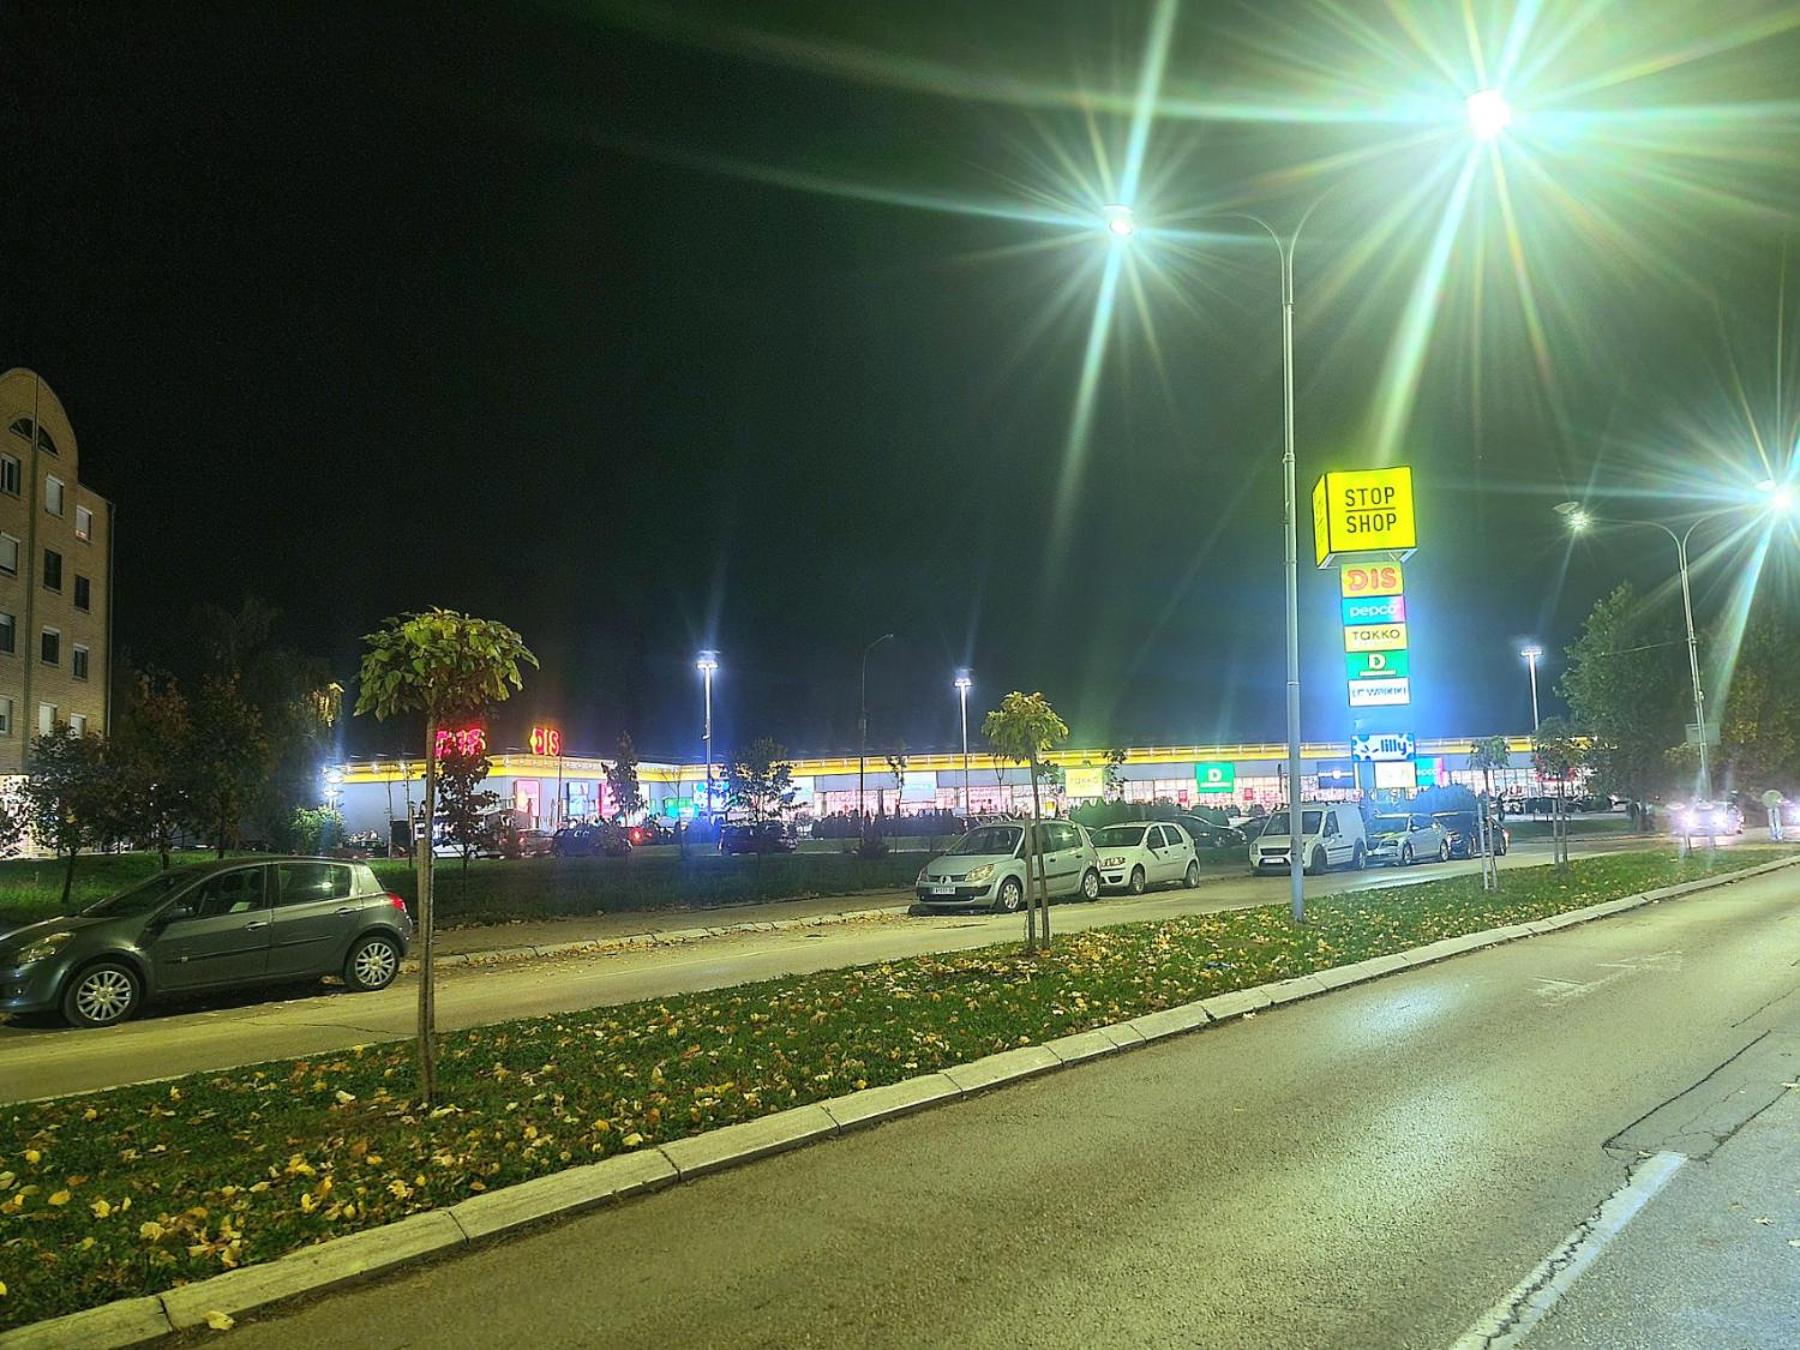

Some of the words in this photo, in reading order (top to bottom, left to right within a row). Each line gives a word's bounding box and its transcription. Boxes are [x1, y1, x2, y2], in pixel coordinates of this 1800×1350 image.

[1345, 486, 1395, 507] STOP
[1346, 513, 1397, 533] SHOP
[1347, 567, 1397, 591] DIS
[1349, 603, 1397, 618] pepco
[1368, 652, 1386, 670] D
[529, 728, 559, 756] DIS
[1381, 739, 1406, 756] lilly
[1207, 768, 1223, 782] D
